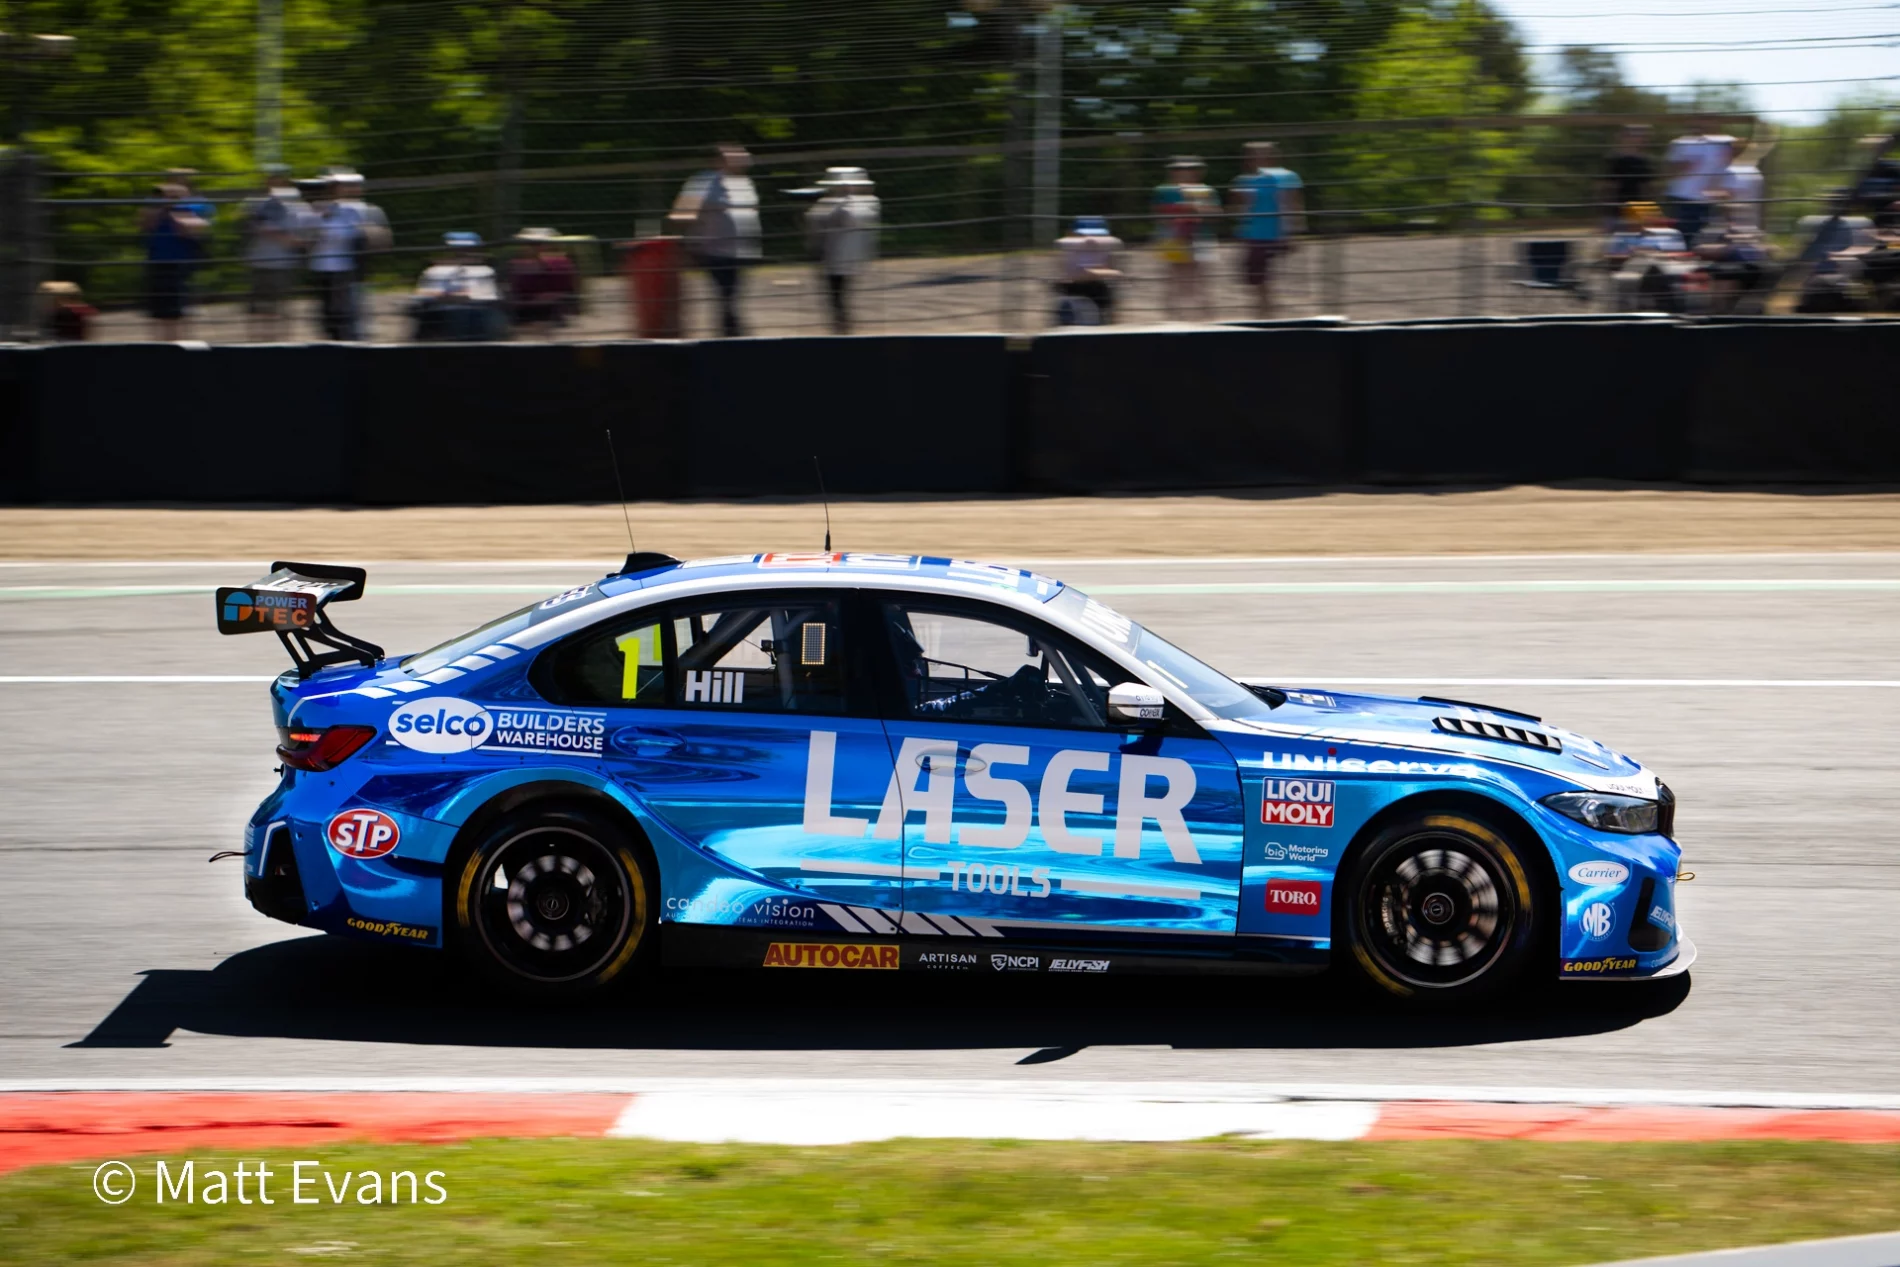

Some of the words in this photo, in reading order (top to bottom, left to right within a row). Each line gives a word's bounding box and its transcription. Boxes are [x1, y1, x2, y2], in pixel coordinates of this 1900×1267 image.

[255, 595, 307, 608] POWER
[255, 607, 307, 626] TEC
[618, 638, 640, 699] 1
[685, 670, 744, 703] Hill
[395, 709, 486, 736] selco
[497, 713, 605, 735] BUILDERS
[497, 730, 603, 750] WAREHOUSE
[803, 730, 1202, 865] LASER
[1266, 779, 1332, 803] LIQUI
[1265, 802, 1332, 825] MOLY
[335, 813, 392, 852] STP
[1267, 847, 1284, 860] big
[1288, 844, 1328, 857] Motoring
[1289, 853, 1315, 862] World
[947, 860, 1051, 898] TOOLS
[1577, 866, 1622, 879] Carrier
[754, 897, 815, 919] vision
[1582, 902, 1611, 936] MB
[346, 917, 429, 939] GOODYEAR
[760, 919, 814, 927] INTEGRATION
[764, 944, 898, 968] AUTOCAR
[918, 953, 977, 963] ARTISAN
[1007, 956, 1039, 967] NCPI
[1048, 958, 1111, 970] JELLYFISH
[1563, 957, 1637, 972] GOODYEAR
